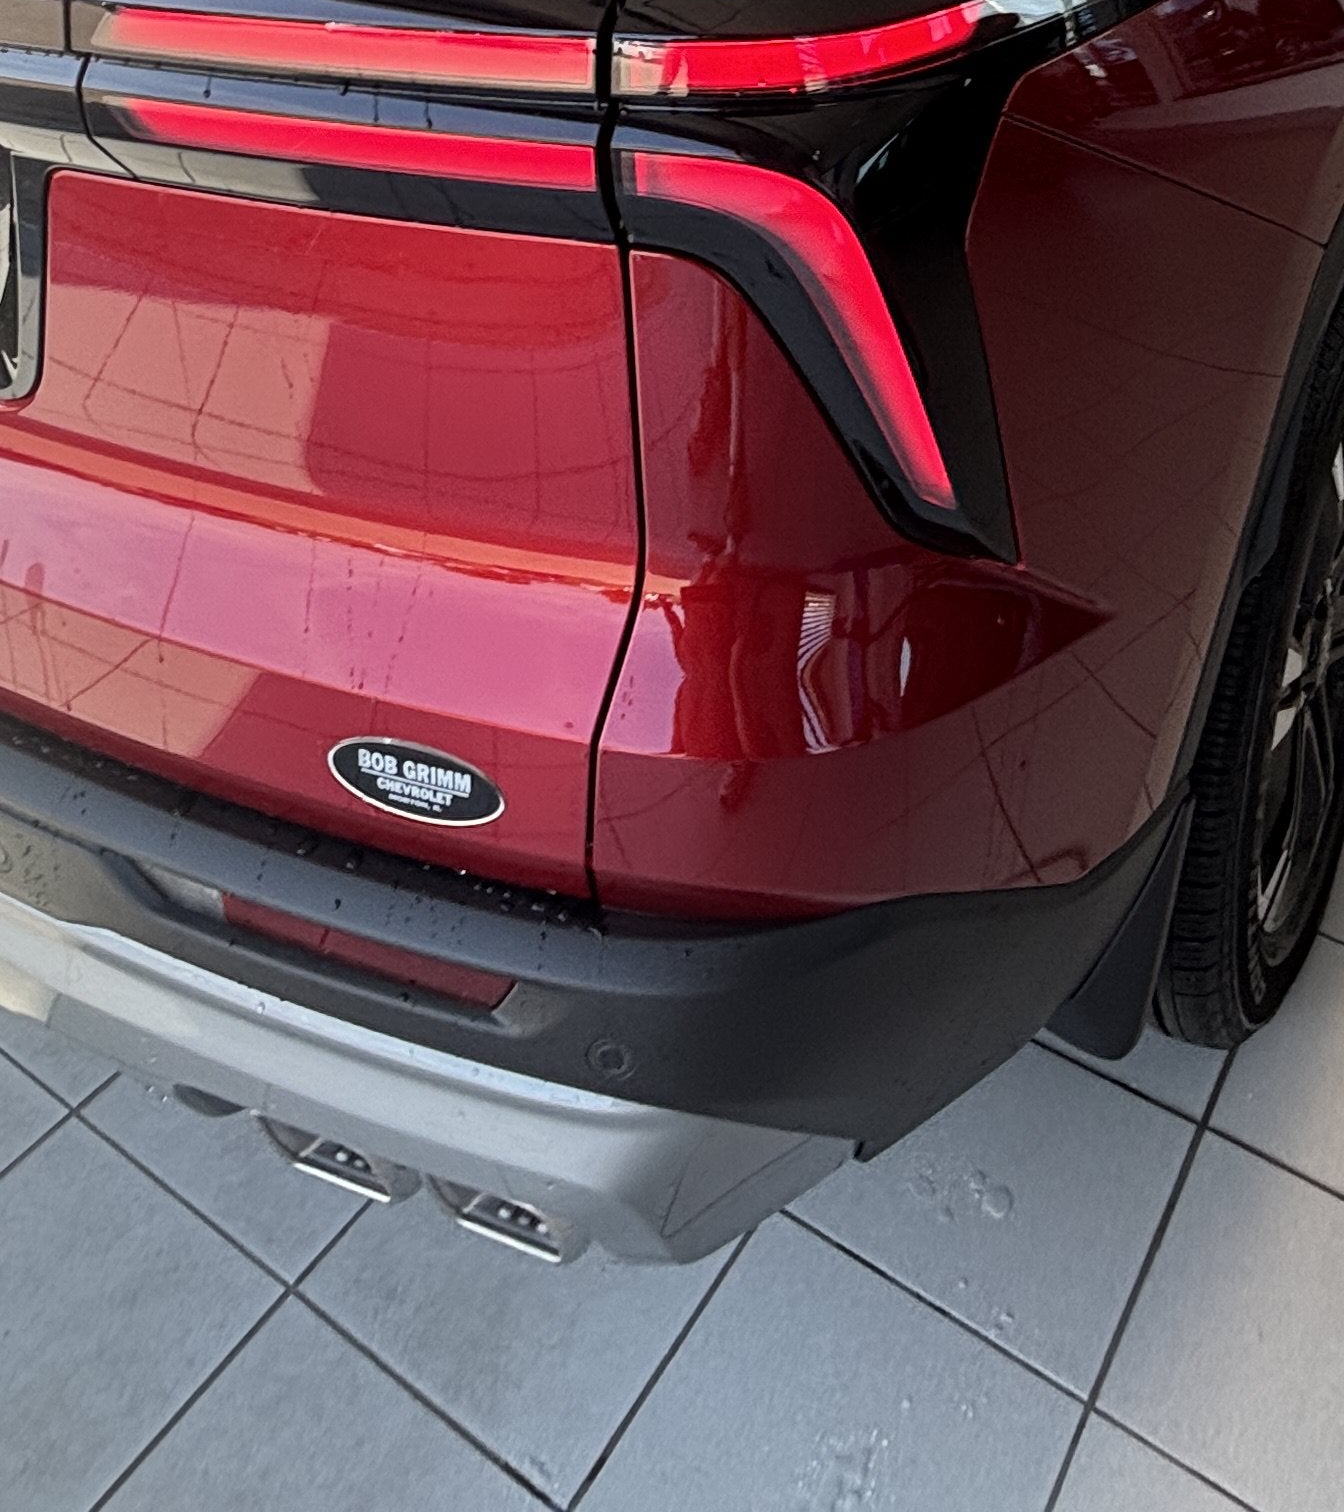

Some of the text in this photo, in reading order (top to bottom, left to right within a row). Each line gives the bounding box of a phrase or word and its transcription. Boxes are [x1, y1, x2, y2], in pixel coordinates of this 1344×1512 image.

[357, 748, 472, 794] BOB GRIMM
[376, 777, 453, 807] CHEVROLET
